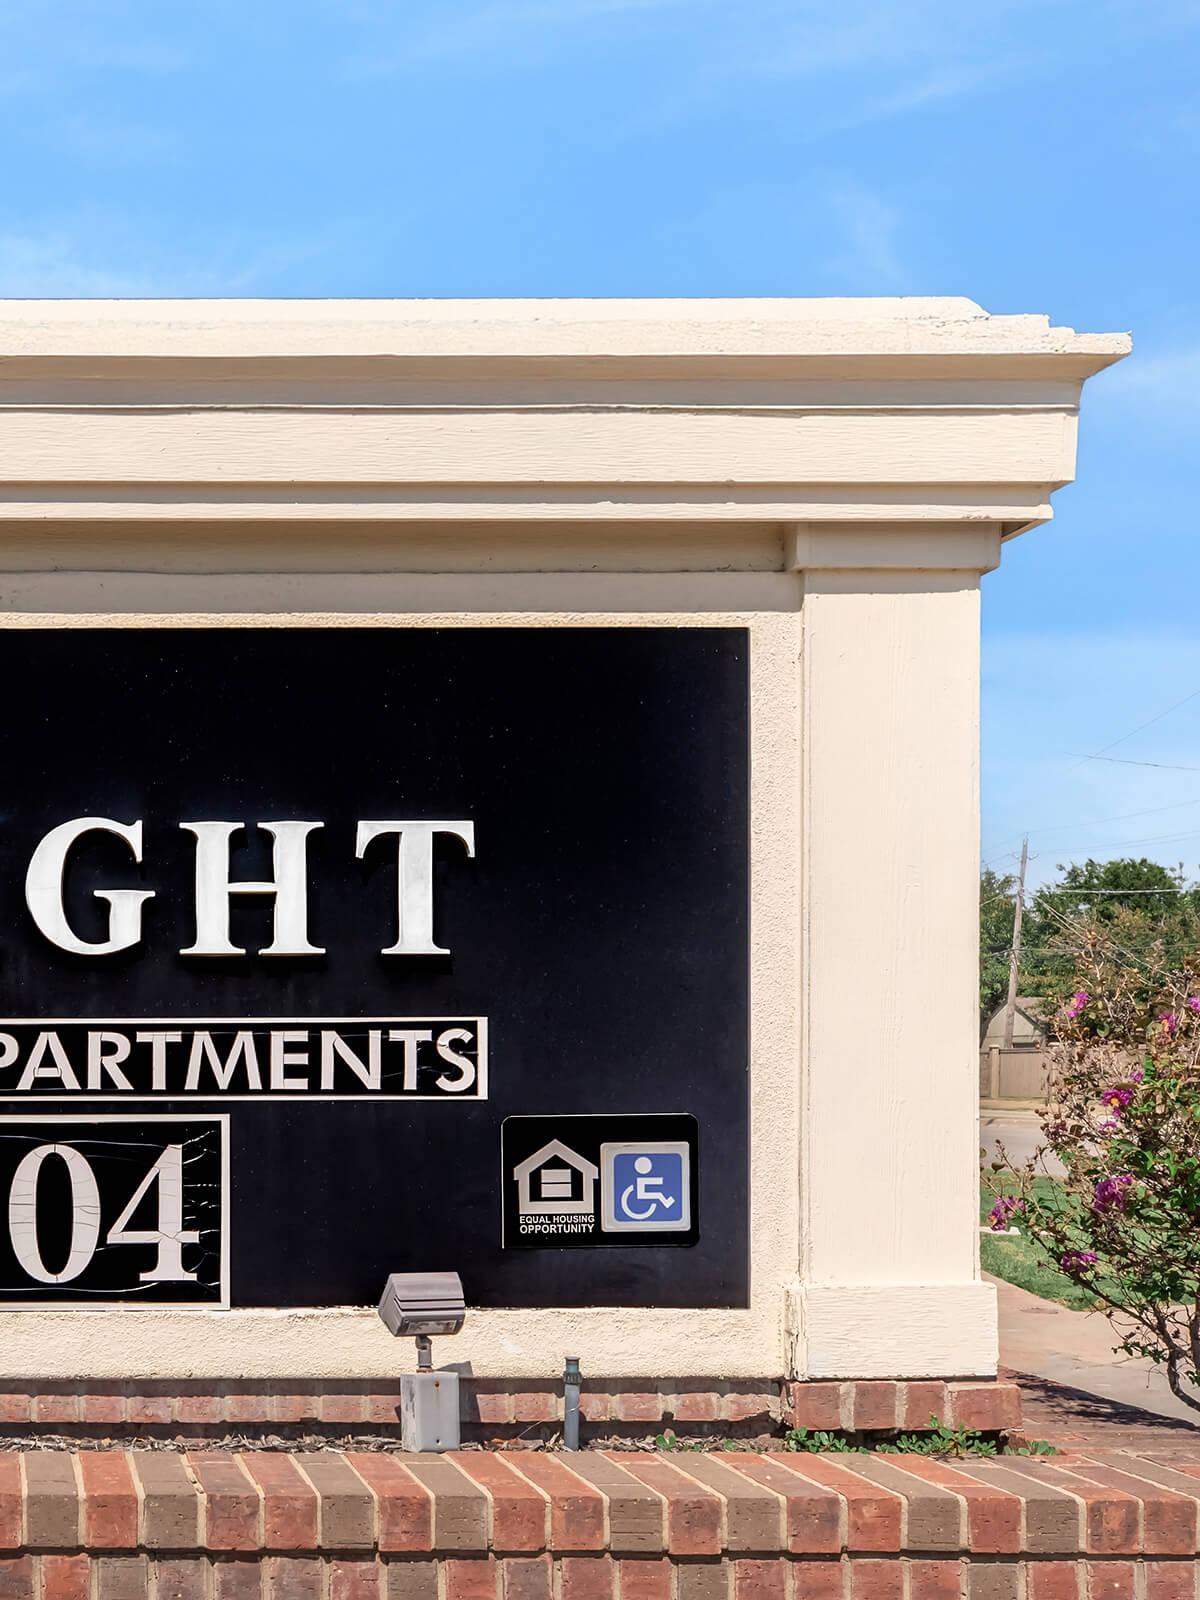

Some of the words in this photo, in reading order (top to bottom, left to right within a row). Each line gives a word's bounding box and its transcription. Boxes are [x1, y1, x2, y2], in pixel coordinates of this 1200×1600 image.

[519, 1215, 551, 1224] EQUAL
[552, 1215, 595, 1224] HOUSING
[519, 1223, 595, 1233] OPPORTUNITY
